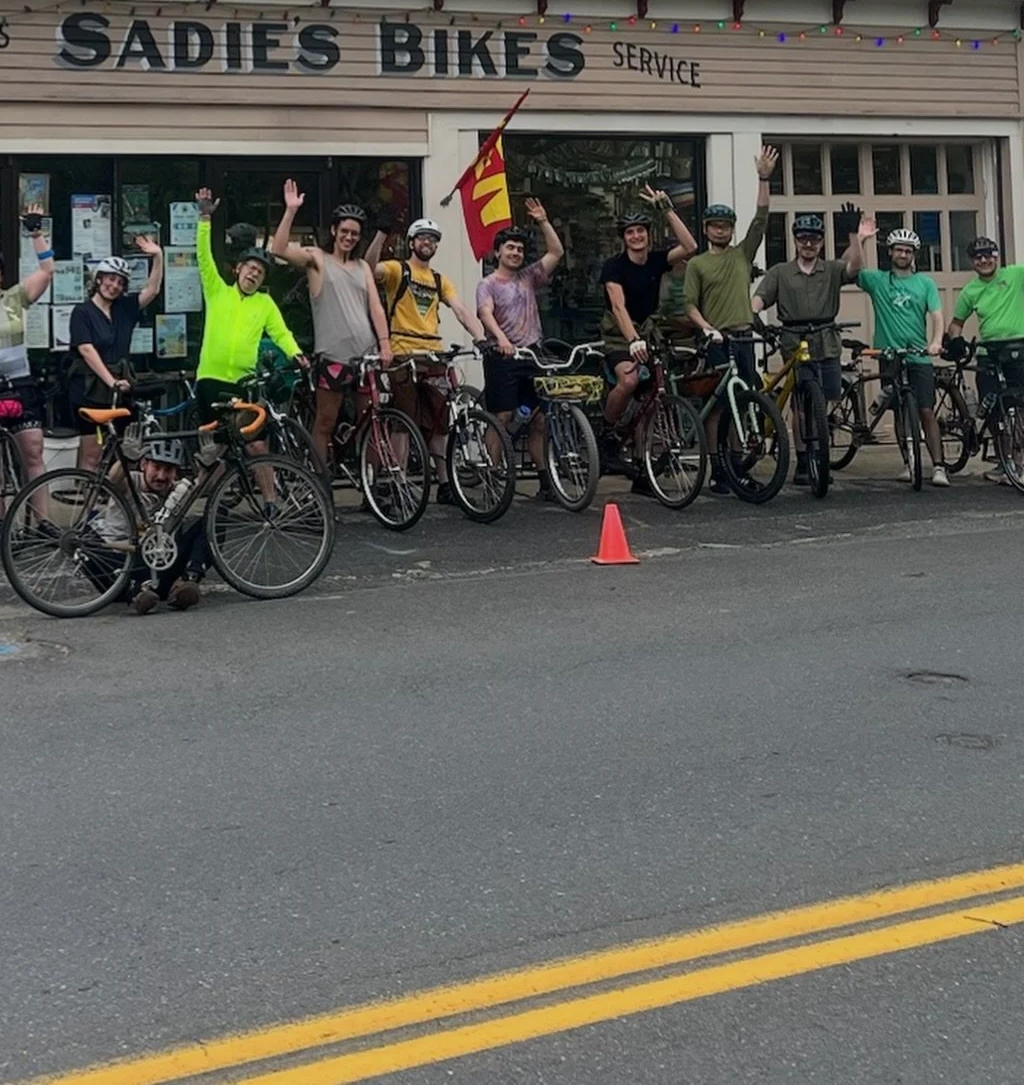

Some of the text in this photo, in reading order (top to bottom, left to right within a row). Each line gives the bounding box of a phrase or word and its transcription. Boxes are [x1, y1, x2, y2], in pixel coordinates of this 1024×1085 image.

[54, 12, 586, 80] SADIE'S BIKES
[612, 42, 702, 89] SERVICE
